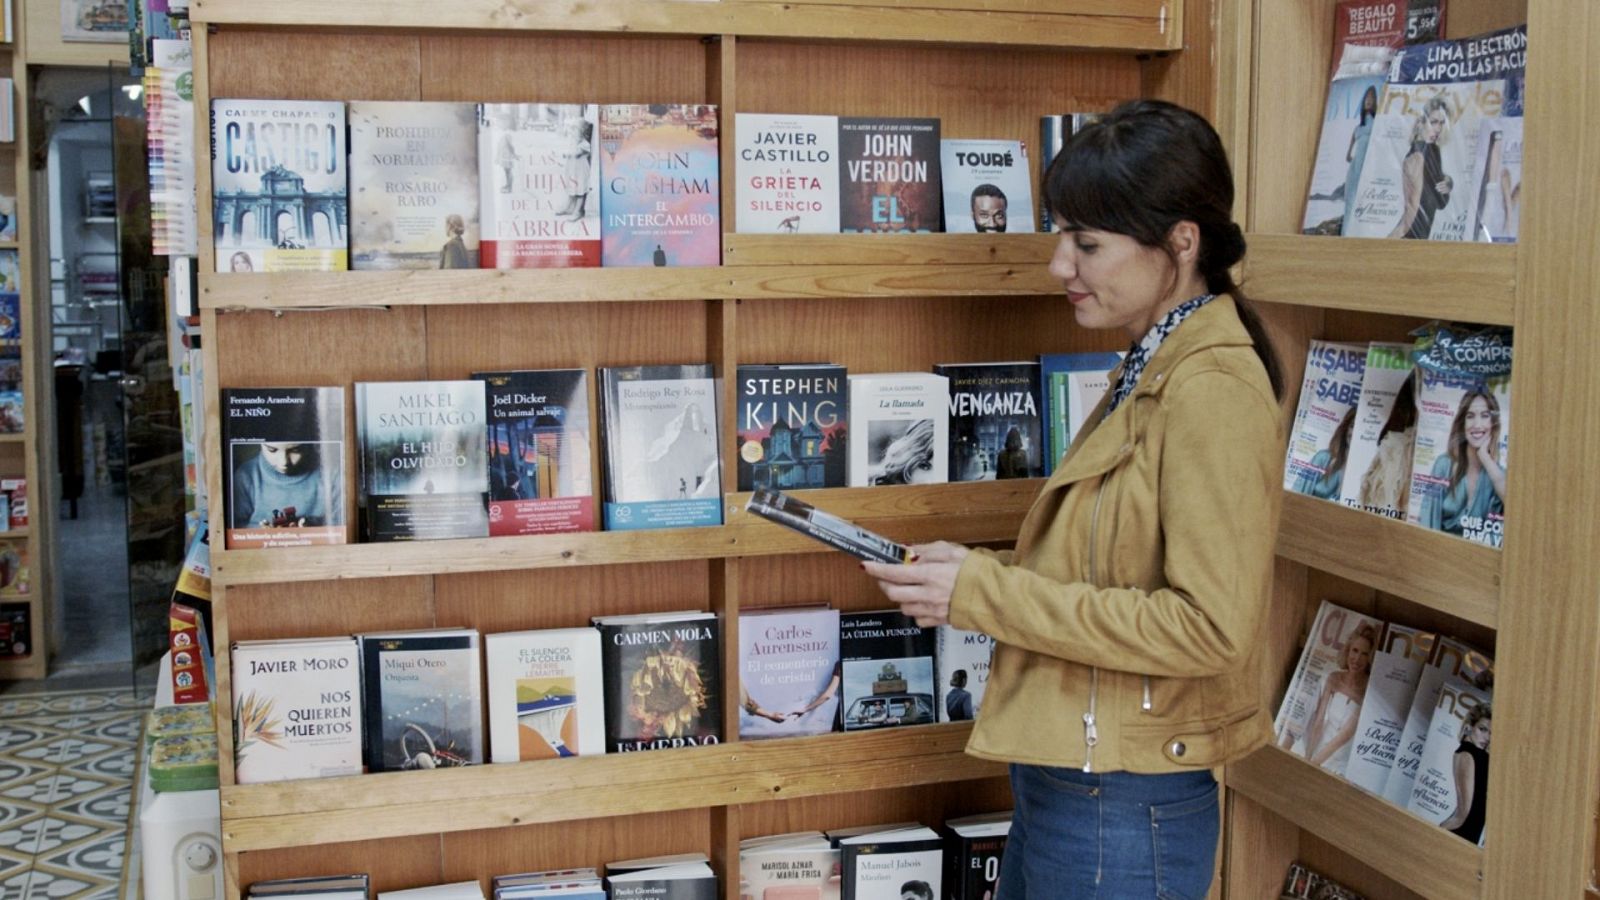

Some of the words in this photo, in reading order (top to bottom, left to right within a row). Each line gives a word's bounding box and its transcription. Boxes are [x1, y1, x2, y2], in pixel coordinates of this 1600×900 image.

[1350, 3, 1396, 21] REGALO
[1349, 16, 1395, 35] BEAUTY
[1427, 46, 1464, 63] LIMA
[1414, 57, 1492, 83] AMPOLLAS
[272, 110, 336, 119] CHAPAO
[754, 132, 817, 145] JAVIER
[863, 134, 912, 157] JOHN
[226, 121, 337, 175] CASTIGO
[407, 140, 425, 153] EN
[741, 149, 830, 163] CASTILLO
[955, 150, 1014, 167] TOURÉ
[848, 160, 928, 183] VERDON
[385, 181, 448, 194] ROSARIO
[750, 176, 822, 190] GRIETA
[397, 195, 437, 208] RARO
[655, 201, 668, 211] EL
[750, 201, 822, 212] SILENCIO
[872, 195, 904, 224] EL
[609, 212, 714, 227] INTERCAMBIO
[745, 378, 838, 395] STEPHEN
[995, 377, 1030, 385] CARMONA
[230, 396, 265, 404] Fernando
[266, 396, 305, 404] Aramburu
[399, 393, 455, 408] MIKEL
[492, 394, 511, 407] Joël
[514, 393, 546, 405] Dicker
[623, 388, 661, 399] Rodrigo
[663, 388, 681, 400] Rey
[879, 400, 890, 408] La
[892, 399, 925, 408] llamada
[949, 391, 1037, 417] VENGANZA
[230, 409, 243, 417] EL
[245, 407, 271, 417] NIÑO
[379, 411, 476, 427] SANTIAGO
[494, 408, 506, 418] Un
[508, 408, 534, 418] animal
[536, 407, 561, 419] salvaje
[746, 401, 838, 430] KING
[403, 442, 417, 454] EL
[391, 456, 467, 469] OLVIDADO
[1461, 515, 1482, 530] QUE
[841, 620, 855, 628] Luis
[856, 619, 882, 627] Landero
[614, 631, 671, 646] CARMEN
[674, 627, 713, 642] MOLA
[765, 625, 812, 640] Carlos
[841, 632, 853, 640] LA
[854, 629, 885, 639] ÚLTIMA
[886, 627, 922, 637] FUNCIÓN
[530, 647, 570, 655] SILENCIO
[750, 641, 829, 656] Aurensanz
[250, 660, 297, 676] JAVIER
[302, 658, 349, 671] MORO
[385, 659, 415, 671] Miqui
[416, 658, 447, 668] Otero
[747, 660, 760, 673] El
[764, 656, 830, 671] cementerio
[760, 673, 775, 685] de
[778, 669, 816, 683] cristal
[320, 691, 351, 704] NOS
[288, 706, 351, 723] QUIEREN
[284, 722, 352, 737] MUERTOS
[761, 862, 789, 871] MARISOL
[791, 860, 813, 869] AZNAR
[861, 859, 894, 871] Manuel
[895, 858, 921, 871] Jabois
[971, 857, 982, 869] EL
[776, 869, 800, 880] MARÍA
[801, 869, 821, 879] FRISA
